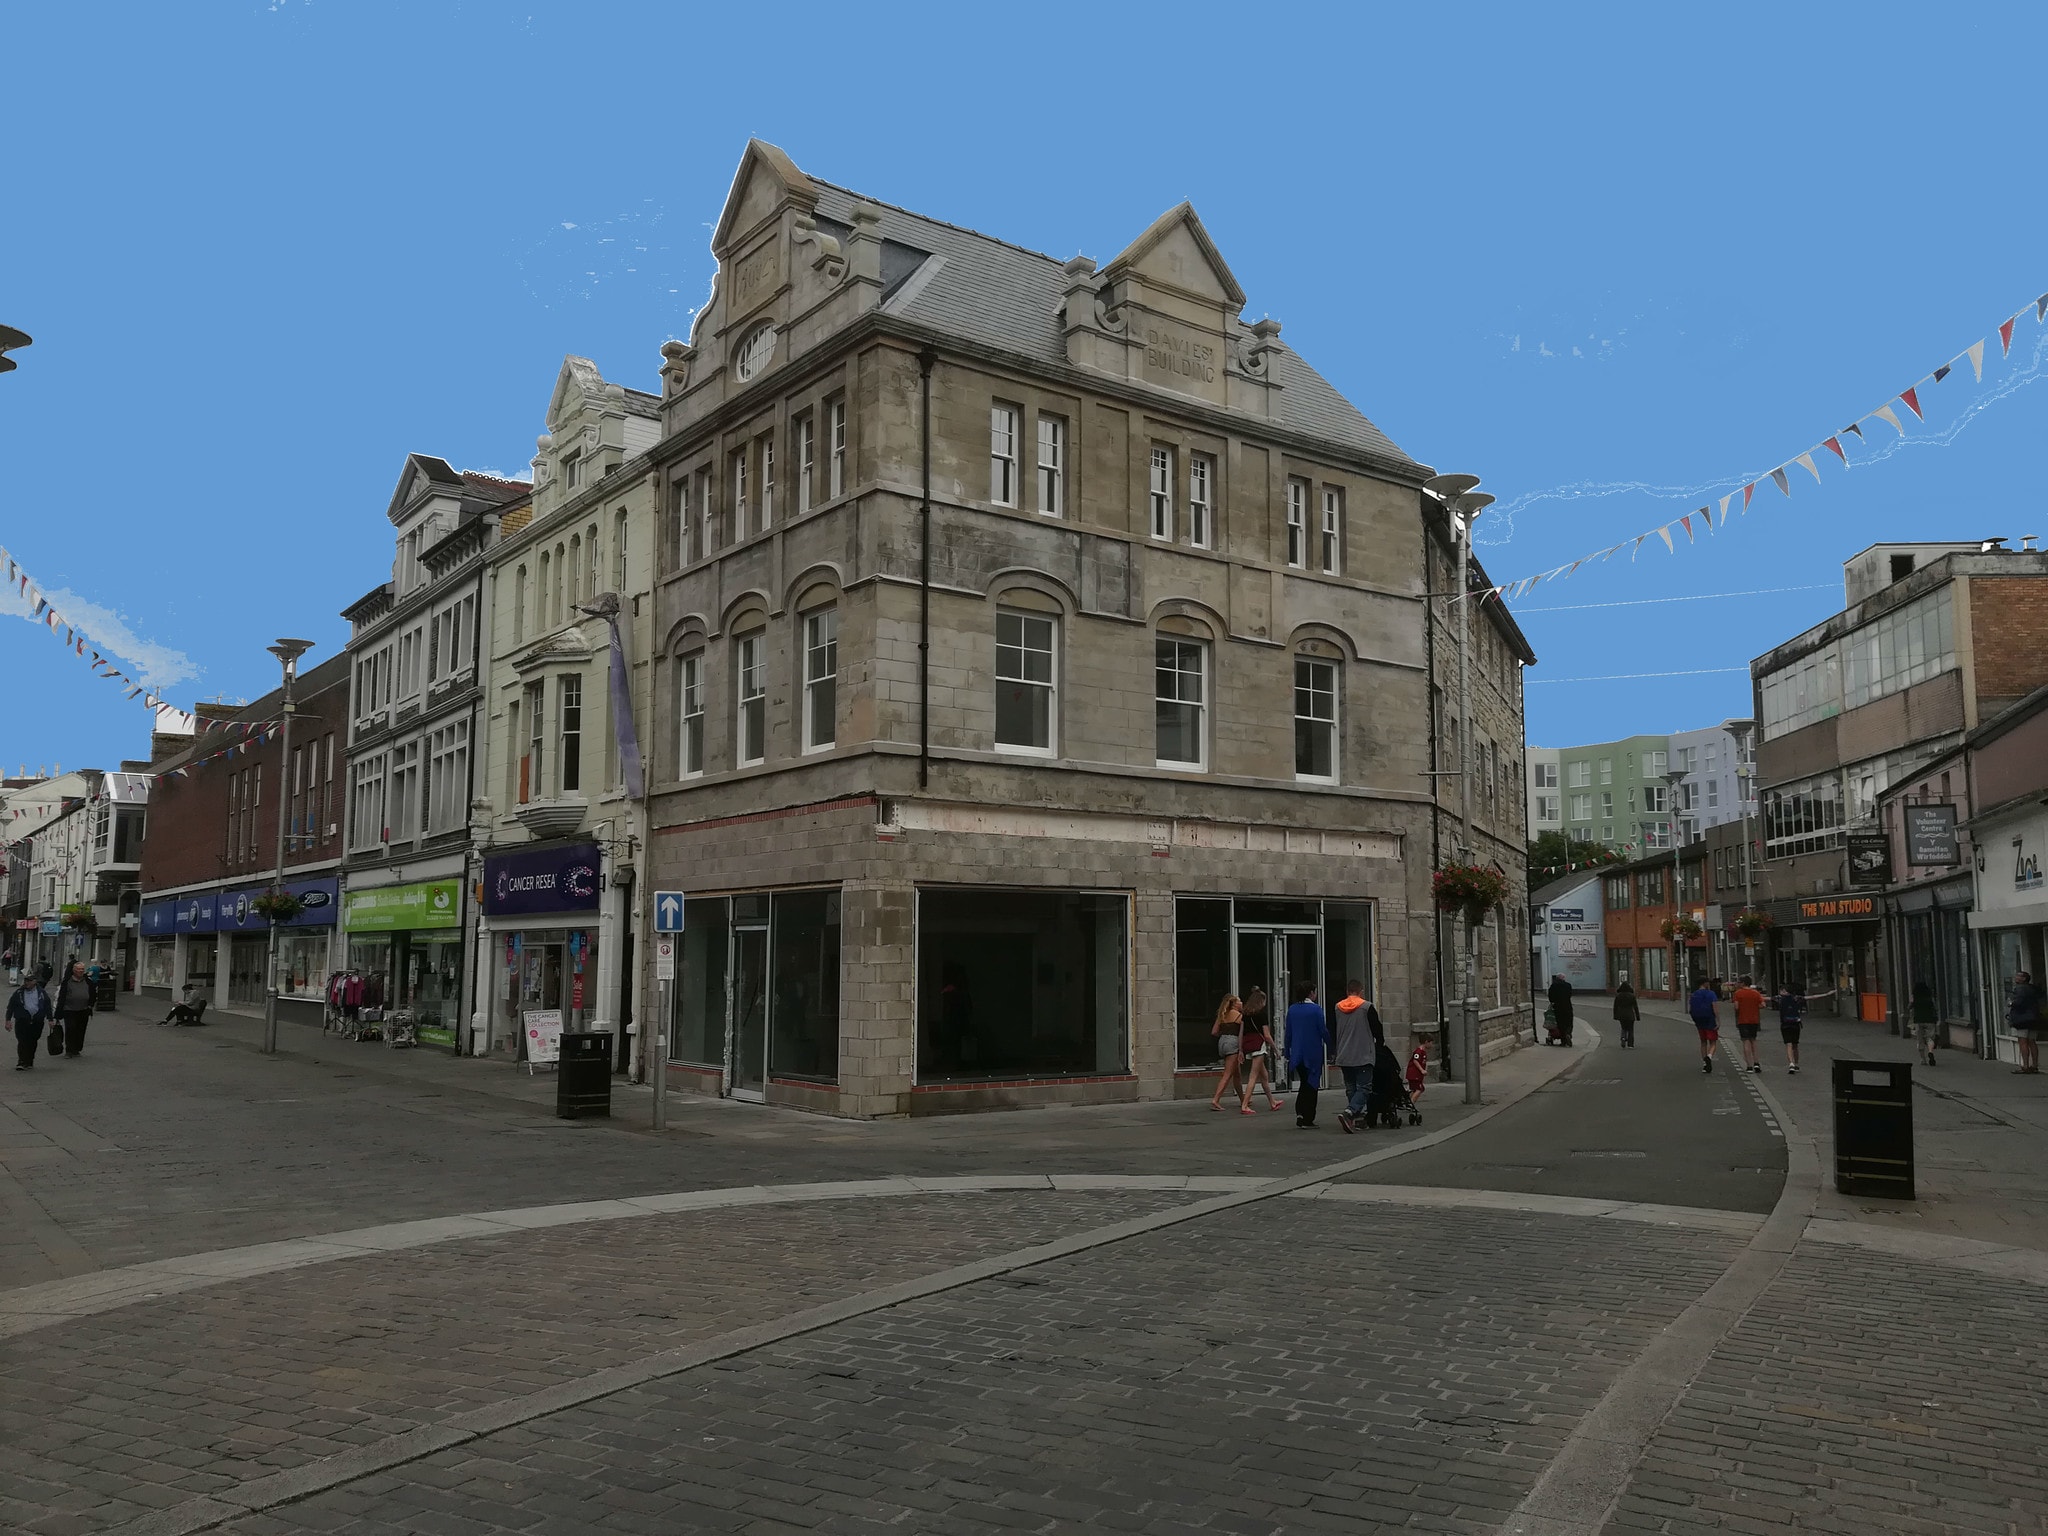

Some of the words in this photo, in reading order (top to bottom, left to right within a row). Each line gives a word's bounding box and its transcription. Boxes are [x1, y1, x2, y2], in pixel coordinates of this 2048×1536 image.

[1149, 329, 1213, 361] DAVIES'
[1148, 348, 1214, 384] BUILDING
[508, 875, 535, 892] CANCER
[535, 873, 558, 889] RESEA
[1801, 902, 1817, 917] THE
[1819, 901, 1836, 915] TAN
[1838, 898, 1873, 914] STUDIO
[1565, 923, 1582, 931] DEN
[1561, 938, 1593, 951] KITCHEN
